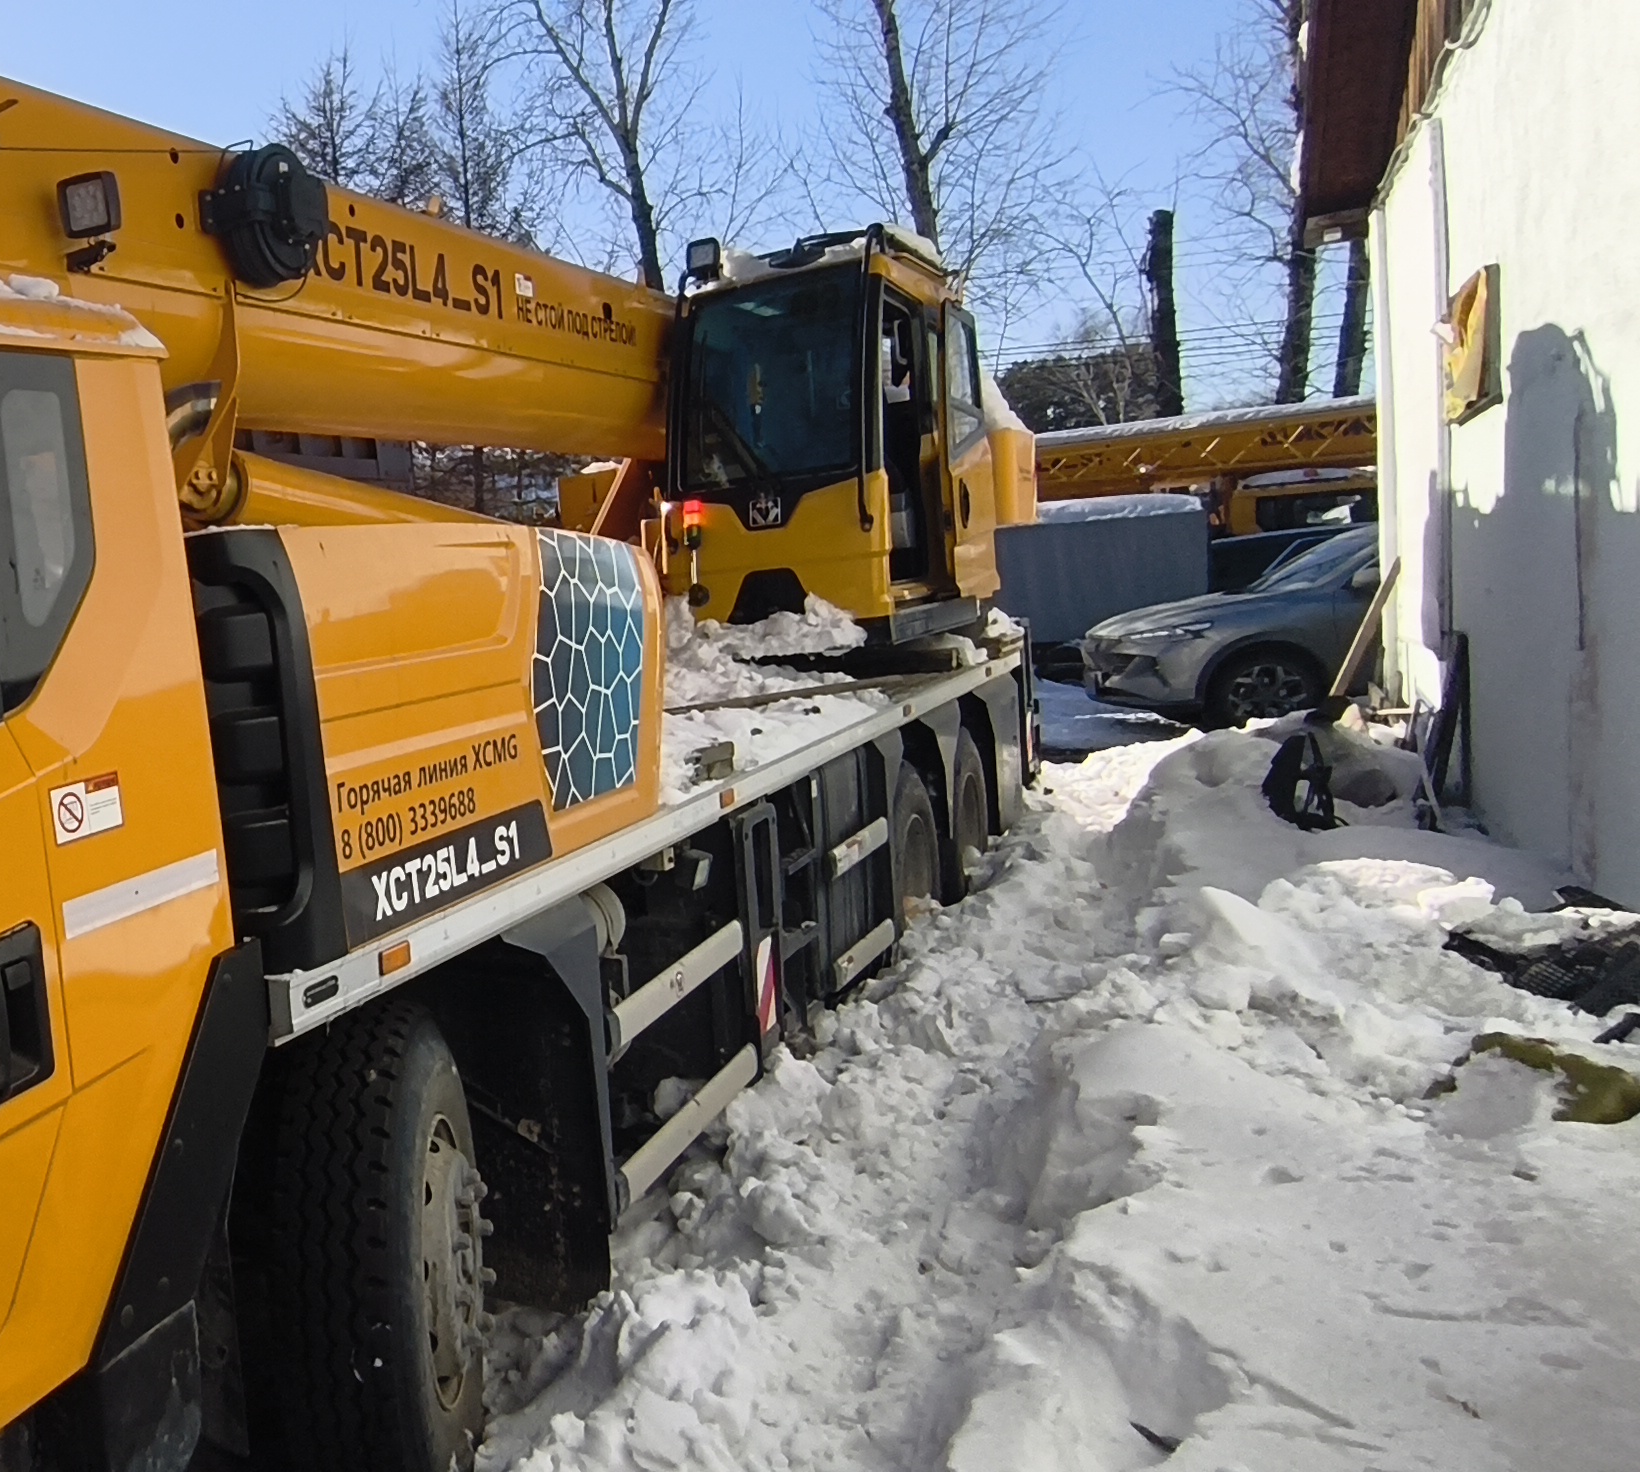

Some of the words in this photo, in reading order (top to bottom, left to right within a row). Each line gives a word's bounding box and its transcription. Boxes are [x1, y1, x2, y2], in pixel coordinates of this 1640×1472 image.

[516, 296, 533, 323] НЕ
[534, 301, 565, 333] СТОЙ
[567, 309, 590, 340] ПОД
[336, 770, 412, 815] Горячая
[417, 755, 468, 788] линия
[472, 734, 518, 771] XCMG
[341, 829, 353, 860] 8
[358, 812, 403, 859] (800)
[408, 787, 476, 836] 3339688
[371, 820, 520, 921] XCT25L4_S1
